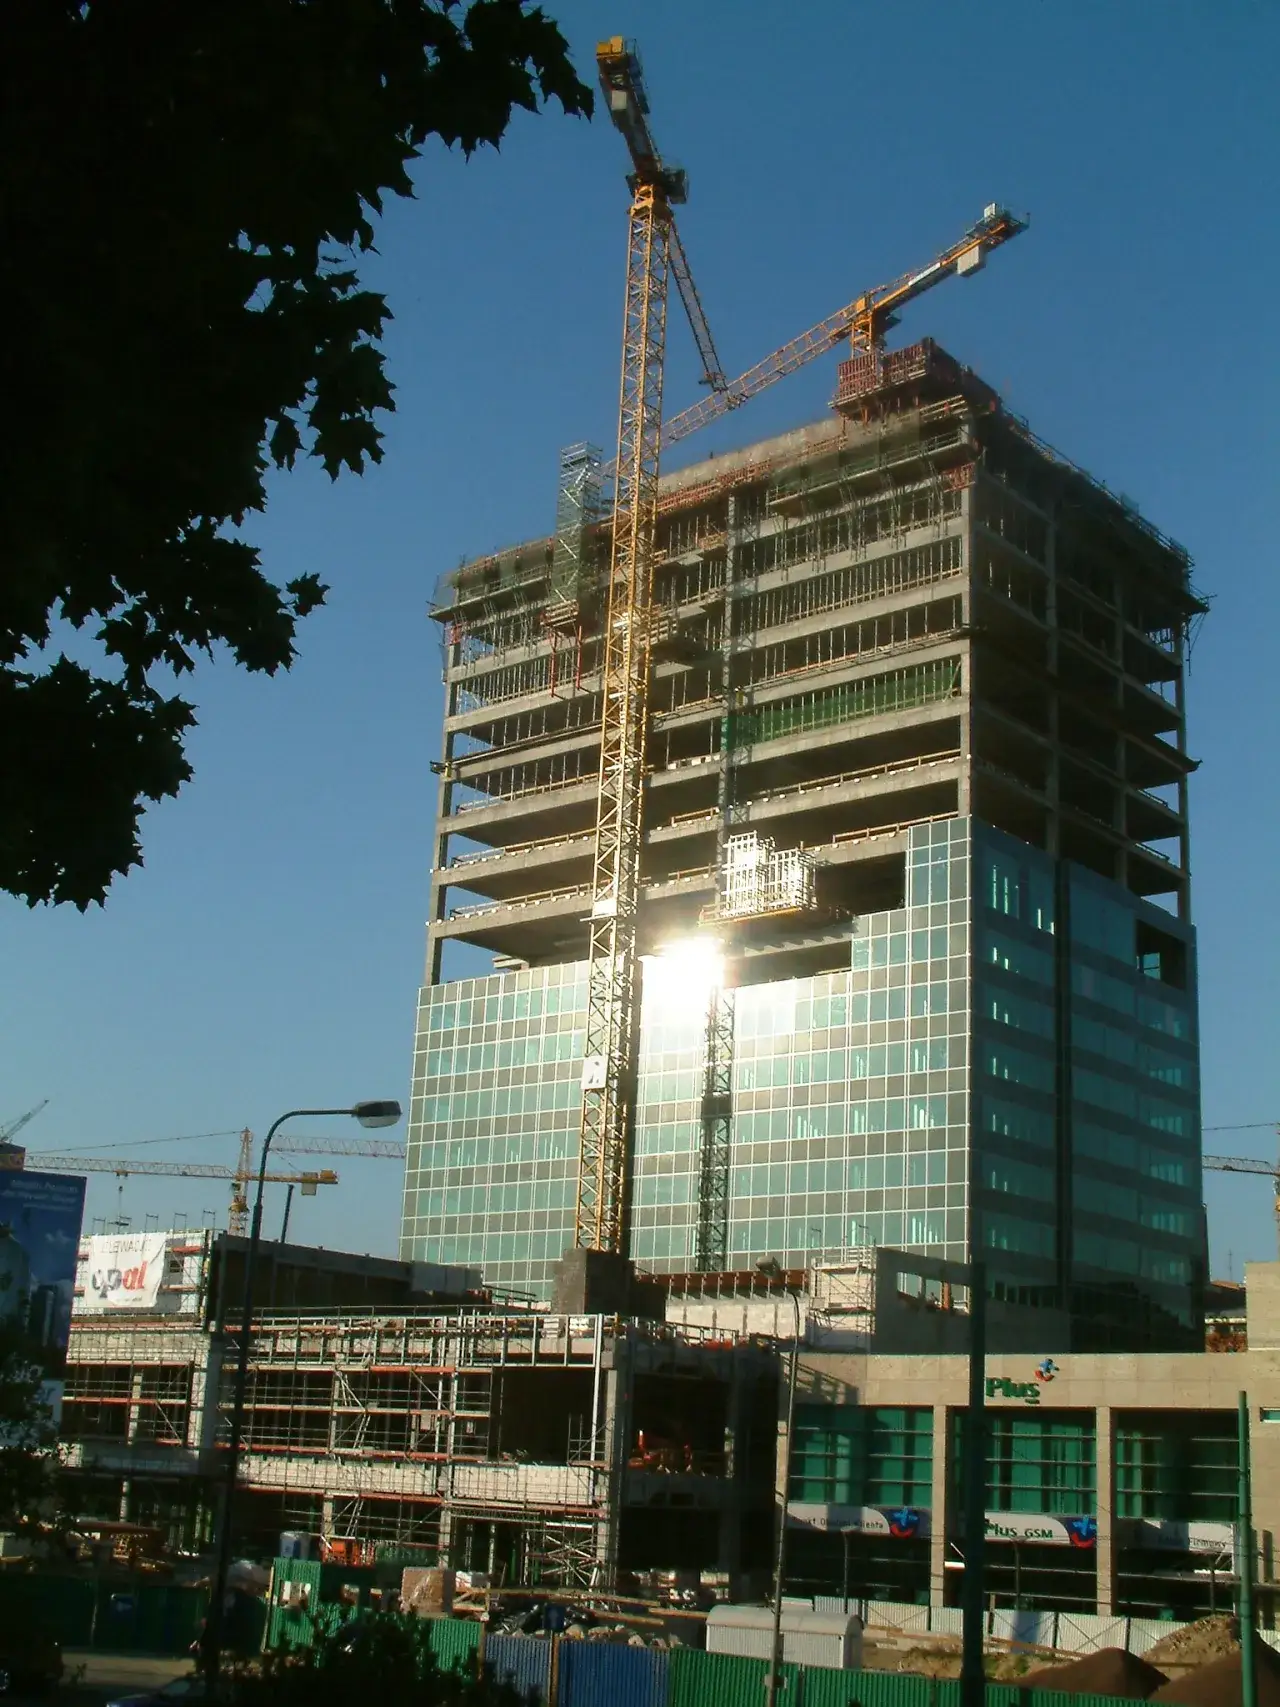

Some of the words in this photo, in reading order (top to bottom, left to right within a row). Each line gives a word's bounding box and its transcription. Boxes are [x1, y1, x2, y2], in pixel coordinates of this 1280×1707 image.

[92, 1260, 149, 1299] opal
[985, 1377, 1040, 1399] Plus
[984, 1522, 1018, 1538] Plus
[1024, 1527, 1054, 1539] GSM
